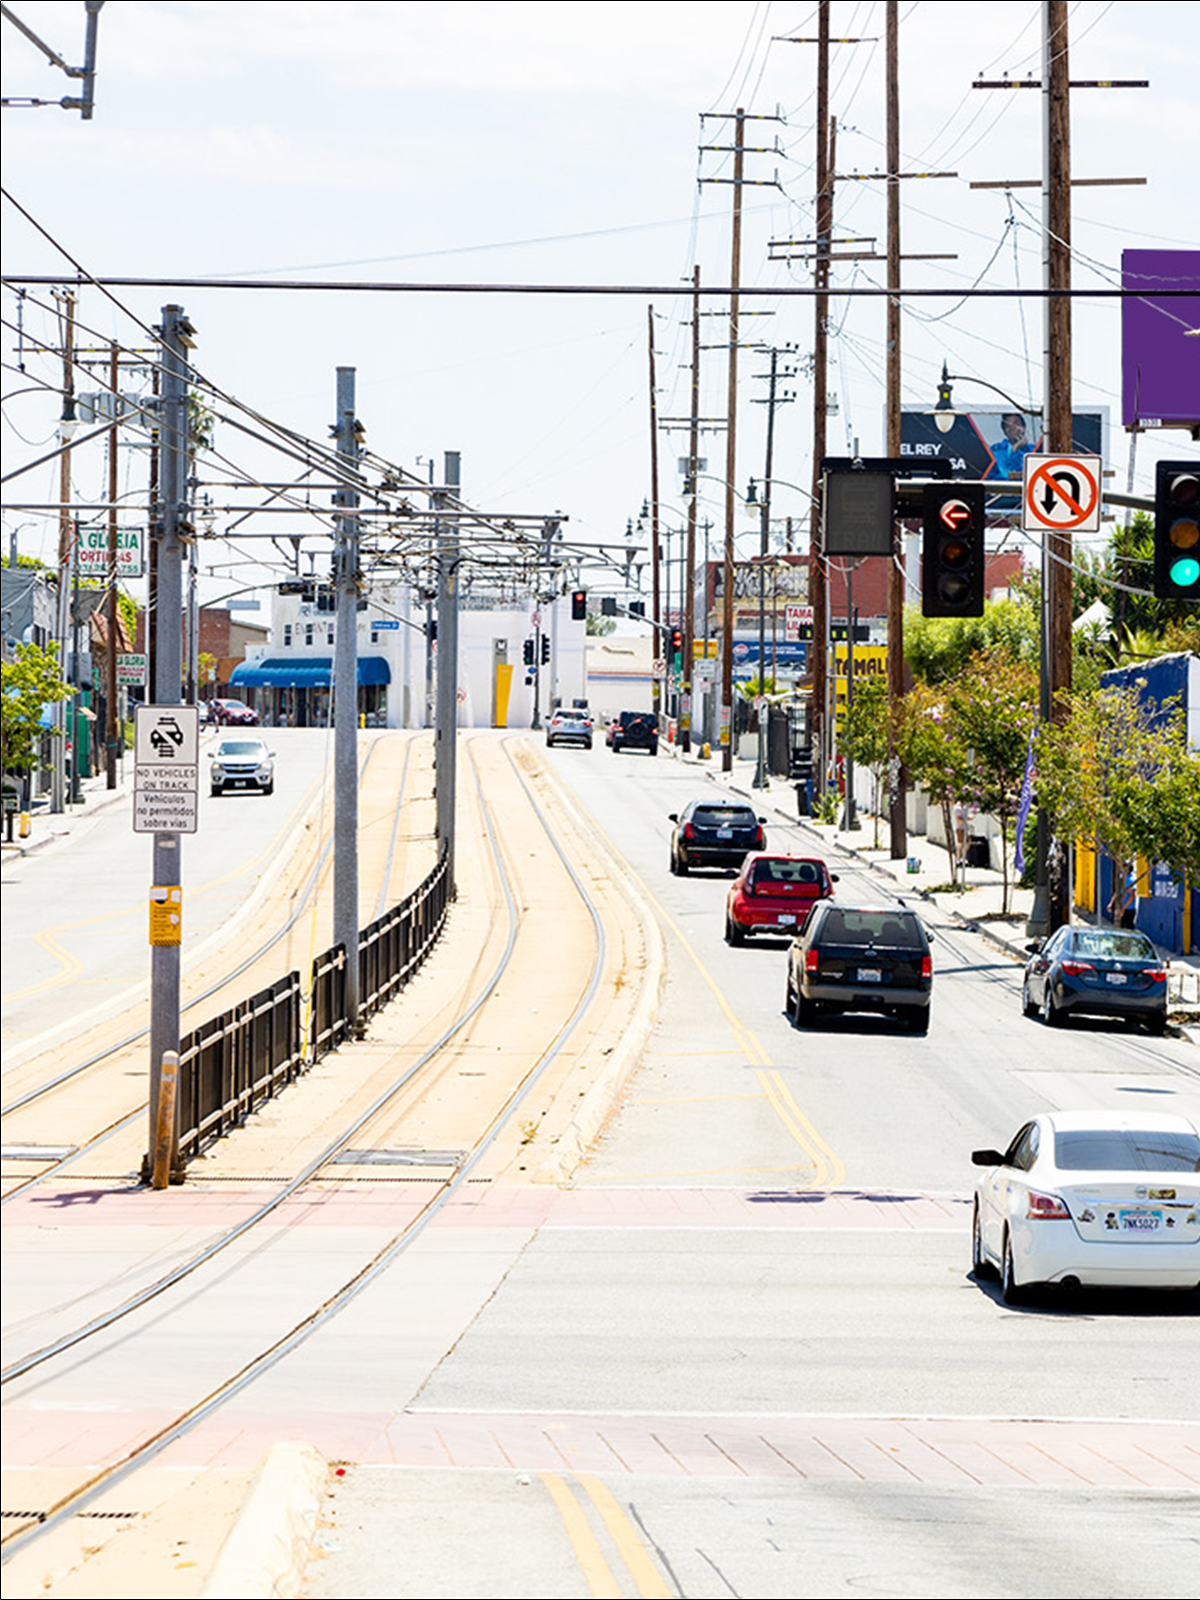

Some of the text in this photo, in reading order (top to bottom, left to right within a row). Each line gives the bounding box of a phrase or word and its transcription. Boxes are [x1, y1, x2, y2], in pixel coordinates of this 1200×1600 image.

[915, 443, 942, 456] REY
[949, 457, 967, 470] SA
[787, 607, 814, 618] TAMA
[836, 657, 889, 676] TAMAL
[136, 769, 196, 778] NO VEHICLES
[143, 781, 189, 790] ON TRACK
[149, 807, 195, 816] permitidos
[143, 819, 168, 828] sobre
